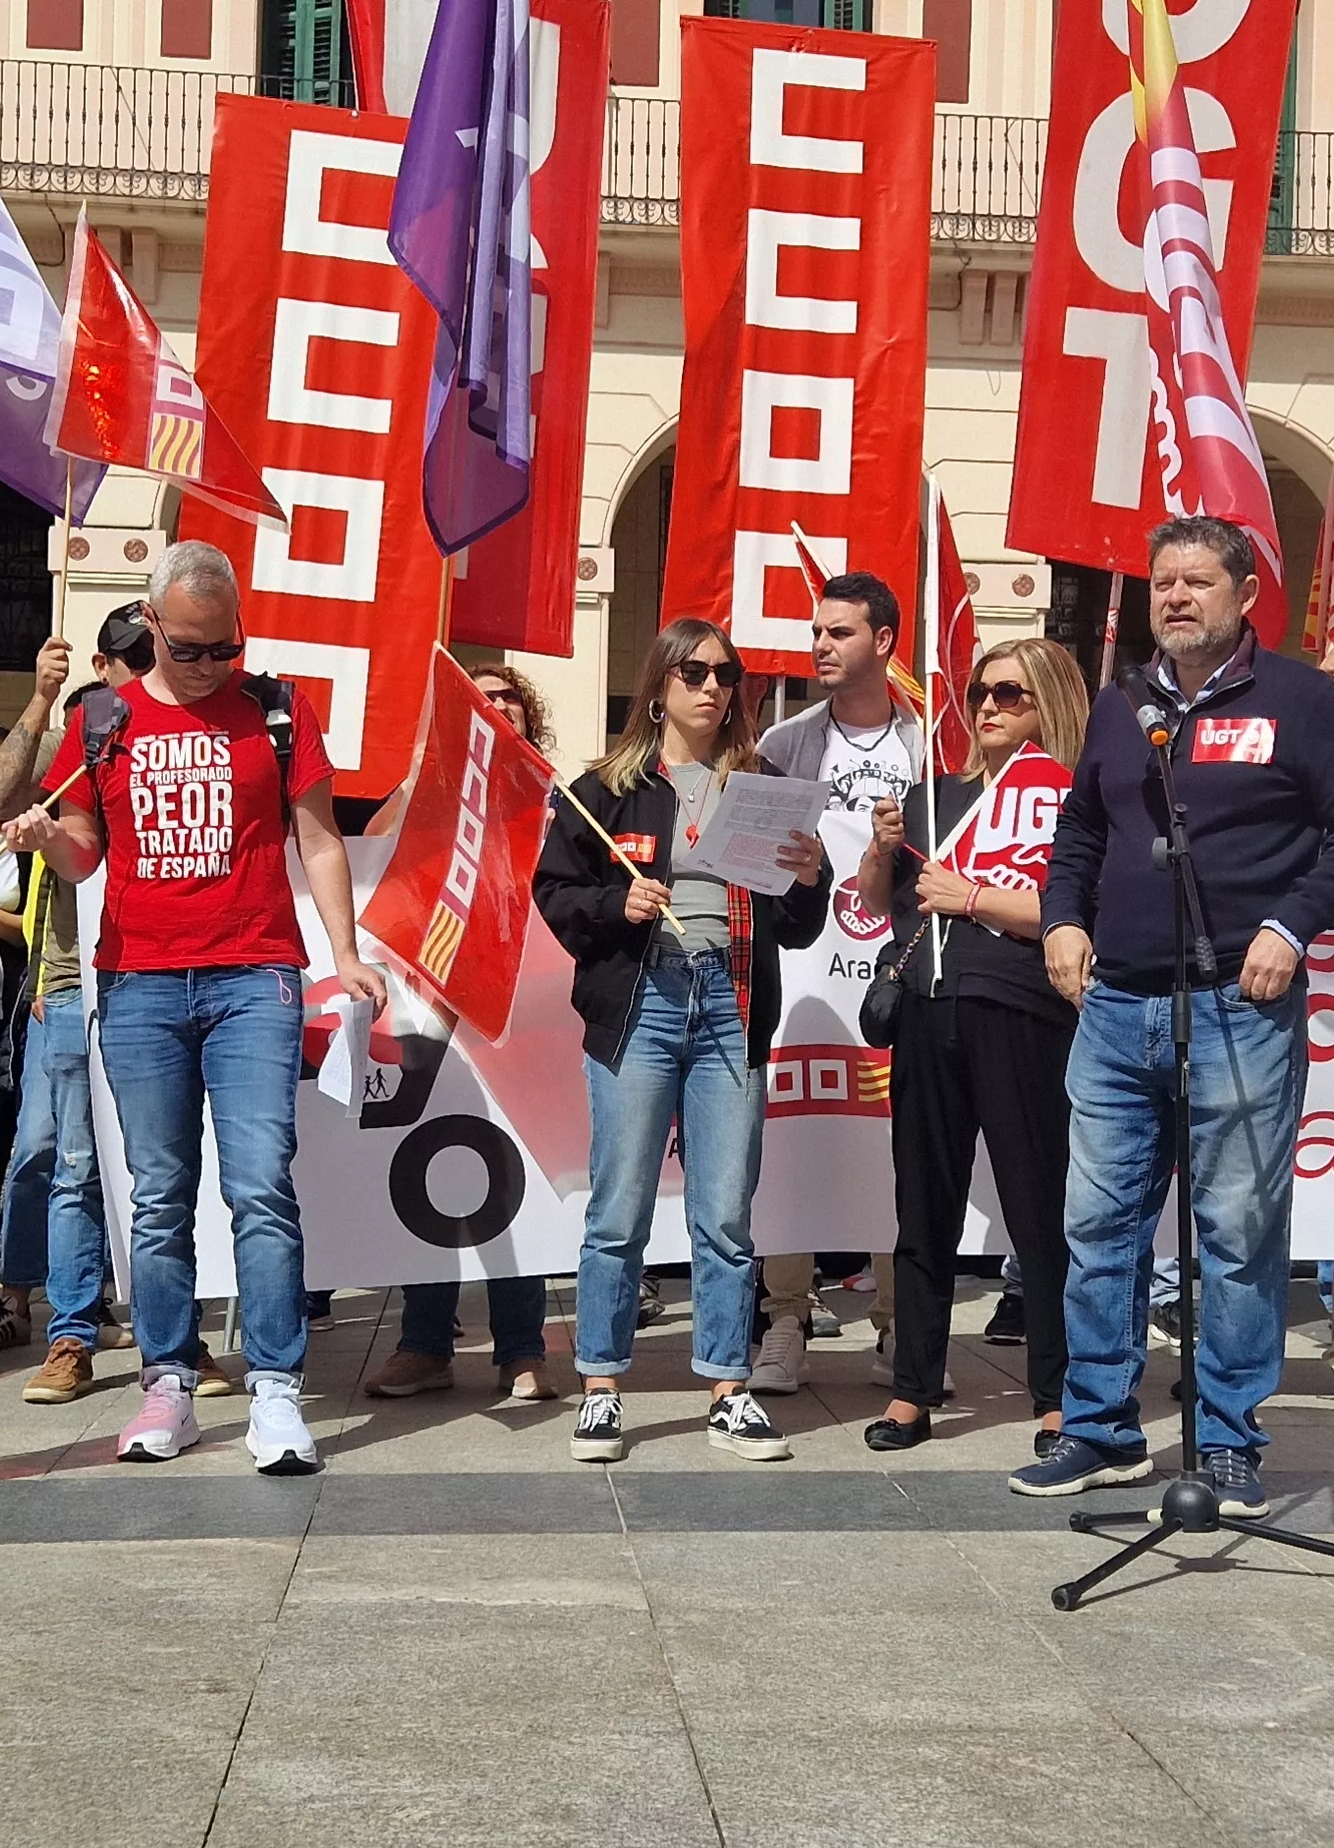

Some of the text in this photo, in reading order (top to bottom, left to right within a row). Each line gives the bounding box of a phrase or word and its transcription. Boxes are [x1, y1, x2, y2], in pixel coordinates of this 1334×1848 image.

[731, 47, 867, 655] CCOO
[1200, 729, 1243, 745] UGT
[130, 735, 231, 773] SOMOS
[130, 766, 232, 787] EL PROFESORADO
[130, 781, 233, 831] PEOR
[974, 786, 1073, 851] UG
[136, 826, 233, 855] TRATADO
[137, 852, 231, 879] DE ESPAÑA
[828, 952, 872, 980] Ara
